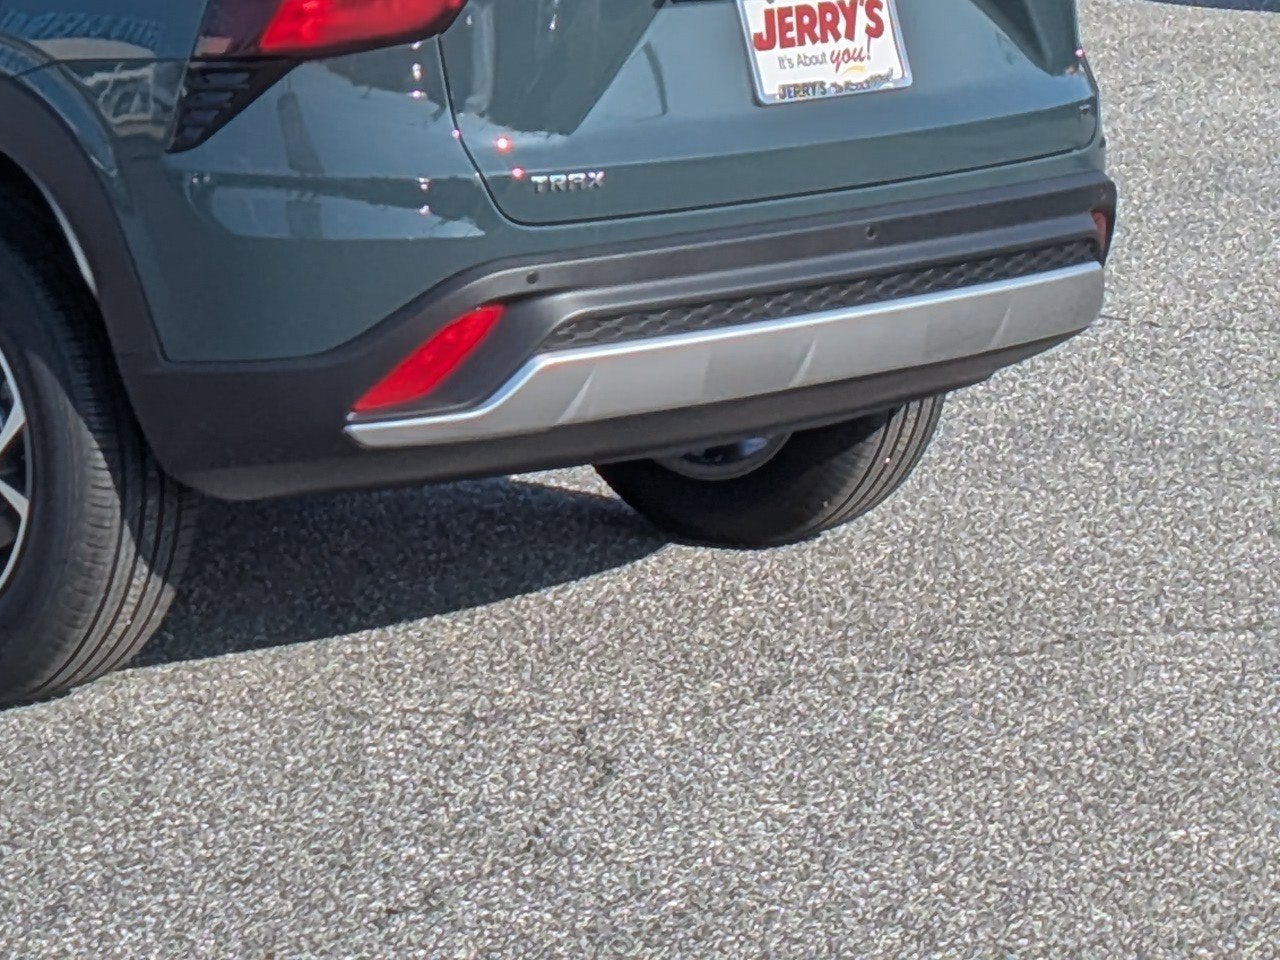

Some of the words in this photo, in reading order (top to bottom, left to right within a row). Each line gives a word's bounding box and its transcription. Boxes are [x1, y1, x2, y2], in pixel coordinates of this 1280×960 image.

[777, 54, 794, 69] It's
[797, 51, 827, 67] About
[531, 171, 604, 193] TRAX
